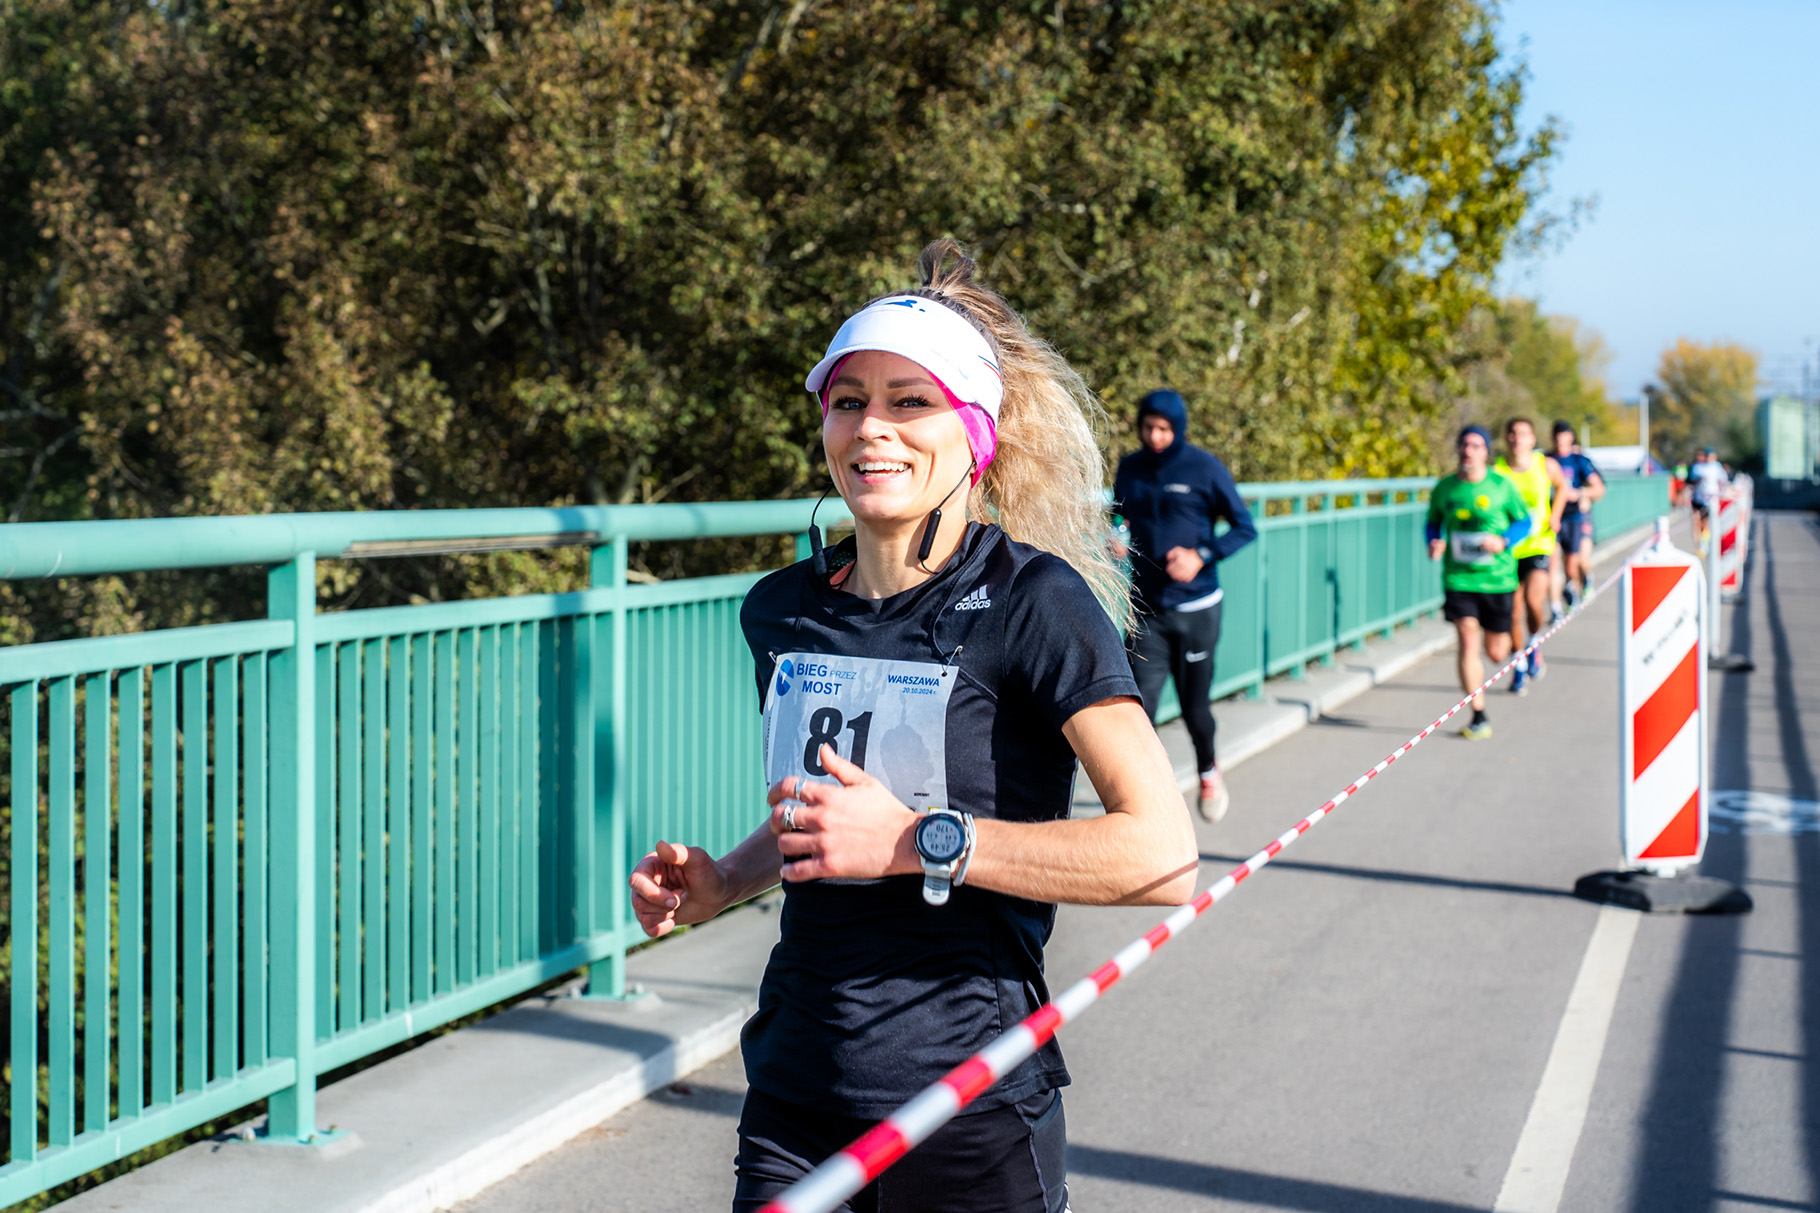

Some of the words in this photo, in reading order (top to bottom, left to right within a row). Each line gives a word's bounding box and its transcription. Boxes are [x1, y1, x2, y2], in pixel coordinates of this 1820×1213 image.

[955, 598, 991, 611] adidas
[796, 662, 828, 677] BIEG
[829, 670, 857, 681] PRZEZ
[802, 680, 842, 696] MOST
[888, 674, 940, 687] WARSZAWA
[804, 707, 873, 777] 81
